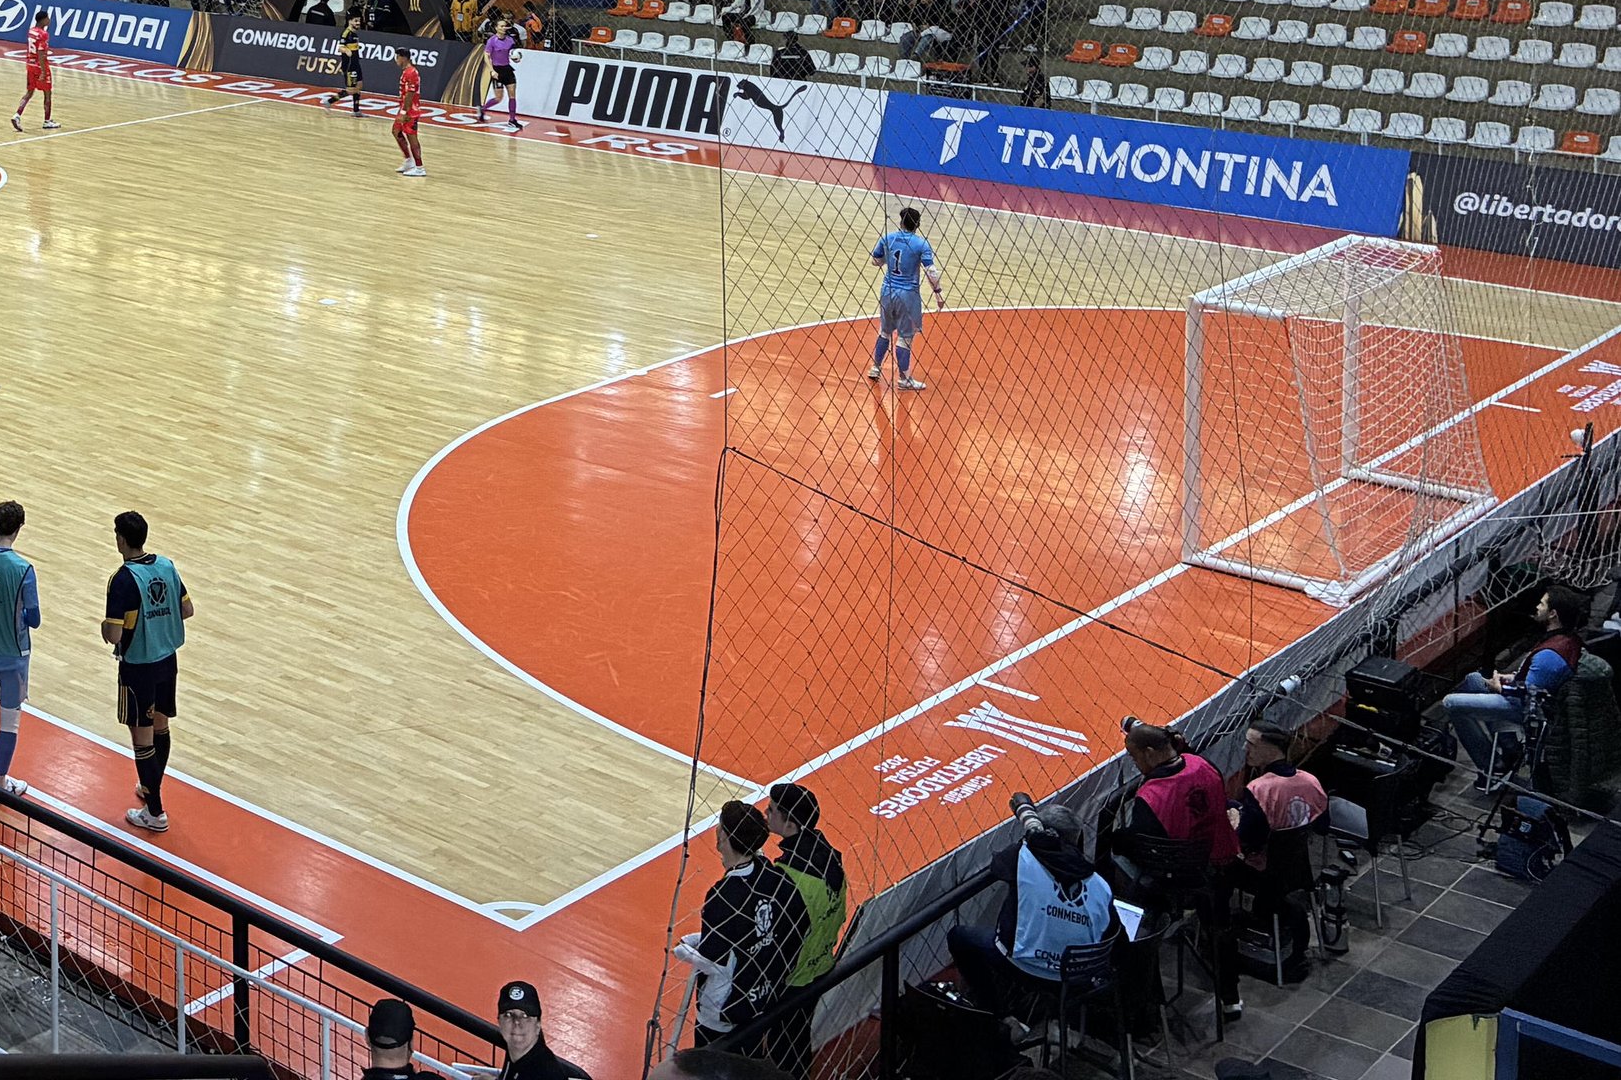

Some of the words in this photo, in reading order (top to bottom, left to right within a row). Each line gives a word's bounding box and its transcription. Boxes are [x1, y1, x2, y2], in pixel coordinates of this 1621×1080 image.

[232, 28, 316, 53] CONMEBOL
[296, 55, 345, 75] FUTSA
[3, 49, 222, 84] CARLOS
[578, 134, 699, 155] RS
[555, 60, 732, 136] PUMA
[997, 124, 1339, 207] TRAMONTINA
[891, 248, 903, 276] 1
[868, 743, 1008, 820] LIBERTADORES
[882, 755, 942, 785] FUTSAL
